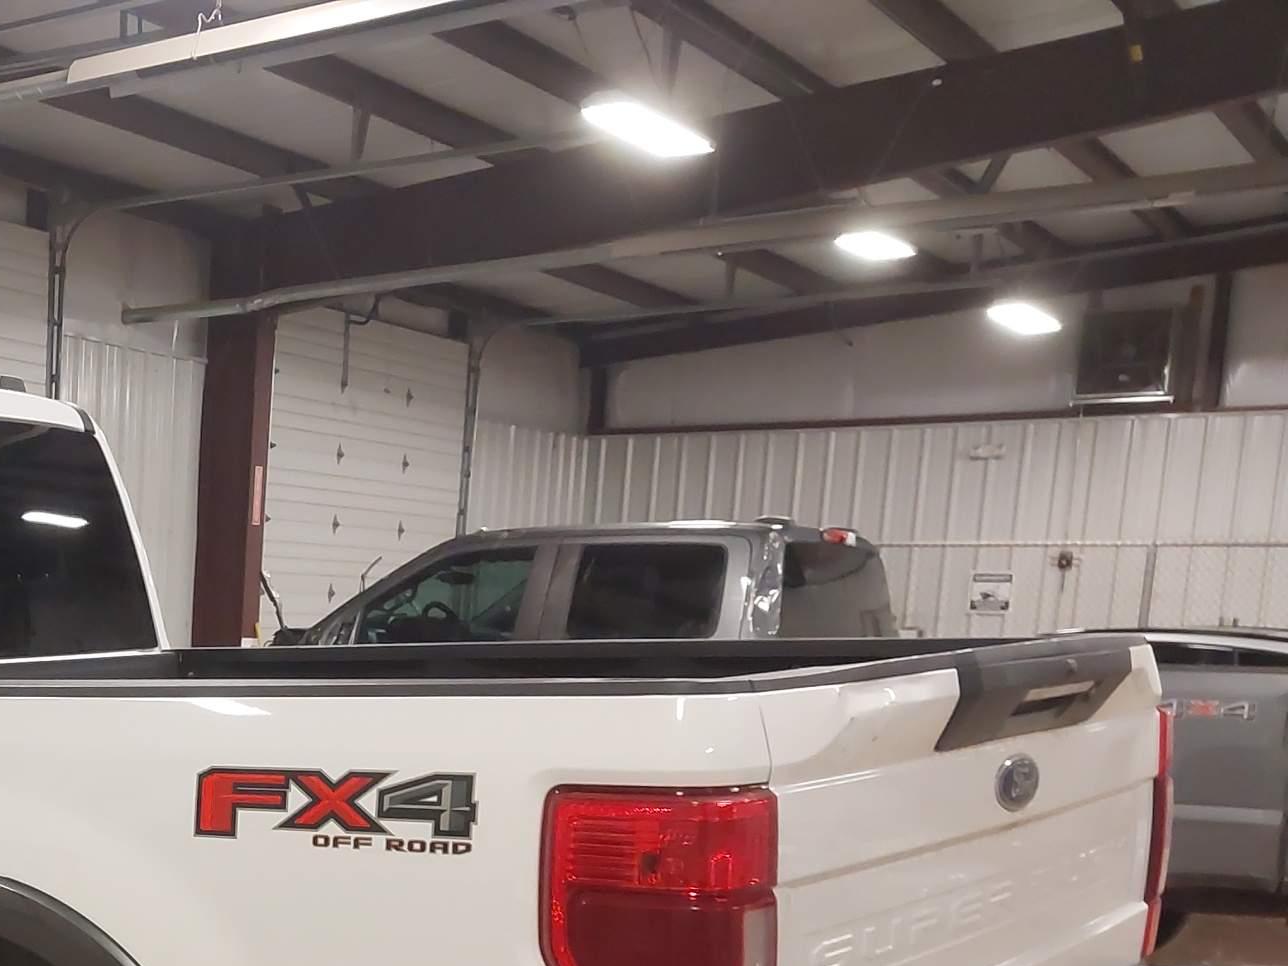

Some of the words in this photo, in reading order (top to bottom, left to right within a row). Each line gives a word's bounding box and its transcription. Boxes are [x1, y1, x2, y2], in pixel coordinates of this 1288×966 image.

[193, 765, 479, 840] FX4
[312, 833, 373, 850] OFF
[385, 839, 473, 855] ROAD
